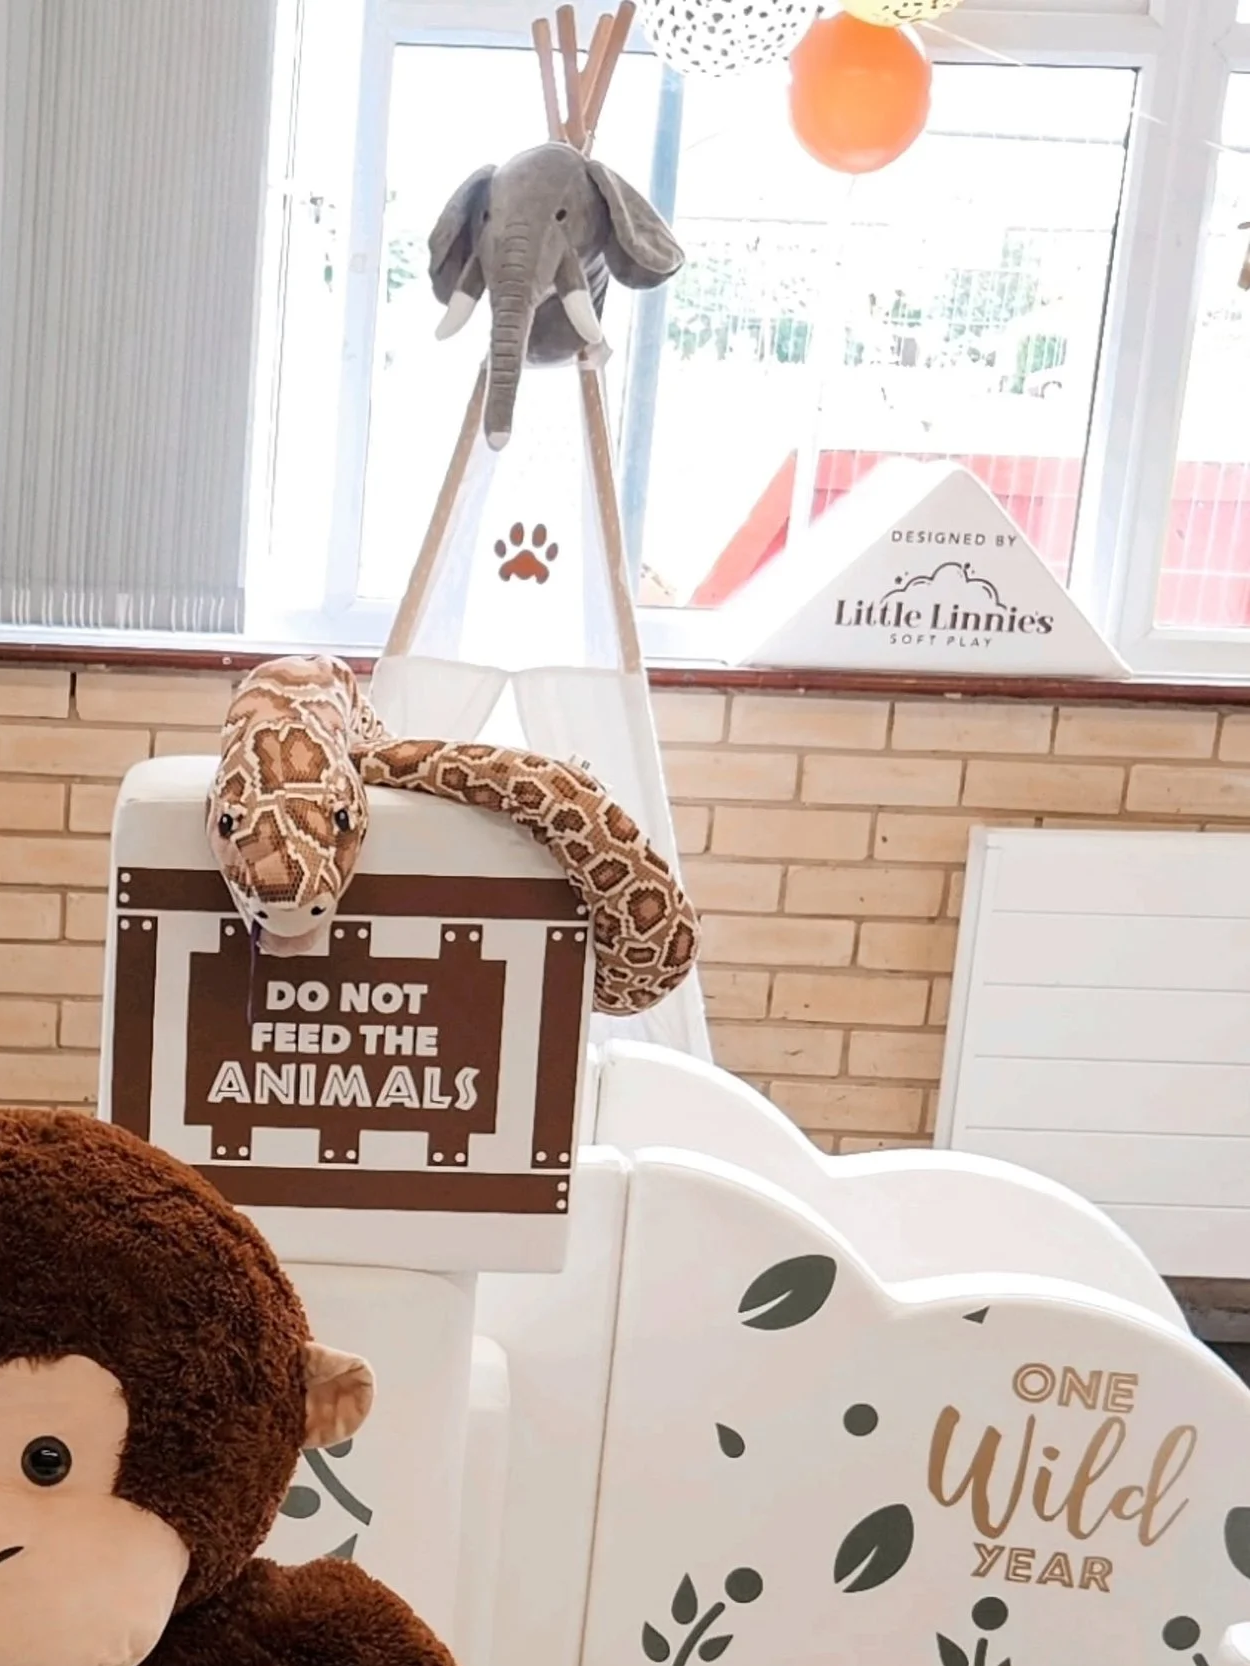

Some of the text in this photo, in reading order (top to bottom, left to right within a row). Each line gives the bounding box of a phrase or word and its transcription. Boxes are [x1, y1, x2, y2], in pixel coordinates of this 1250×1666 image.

[891, 530, 1018, 547] DESIGNED BY
[834, 599, 1055, 635] Little Linnie's
[890, 633, 993, 648] SOFT PLAY
[266, 980, 429, 1014] DO NOT
[251, 1022, 438, 1057] FEED THE
[207, 1059, 480, 1111] ANIMALS
[1012, 1362, 1139, 1413] ONE
[927, 1404, 1198, 1547] Wild
[970, 1541, 1113, 1593] YEAR
